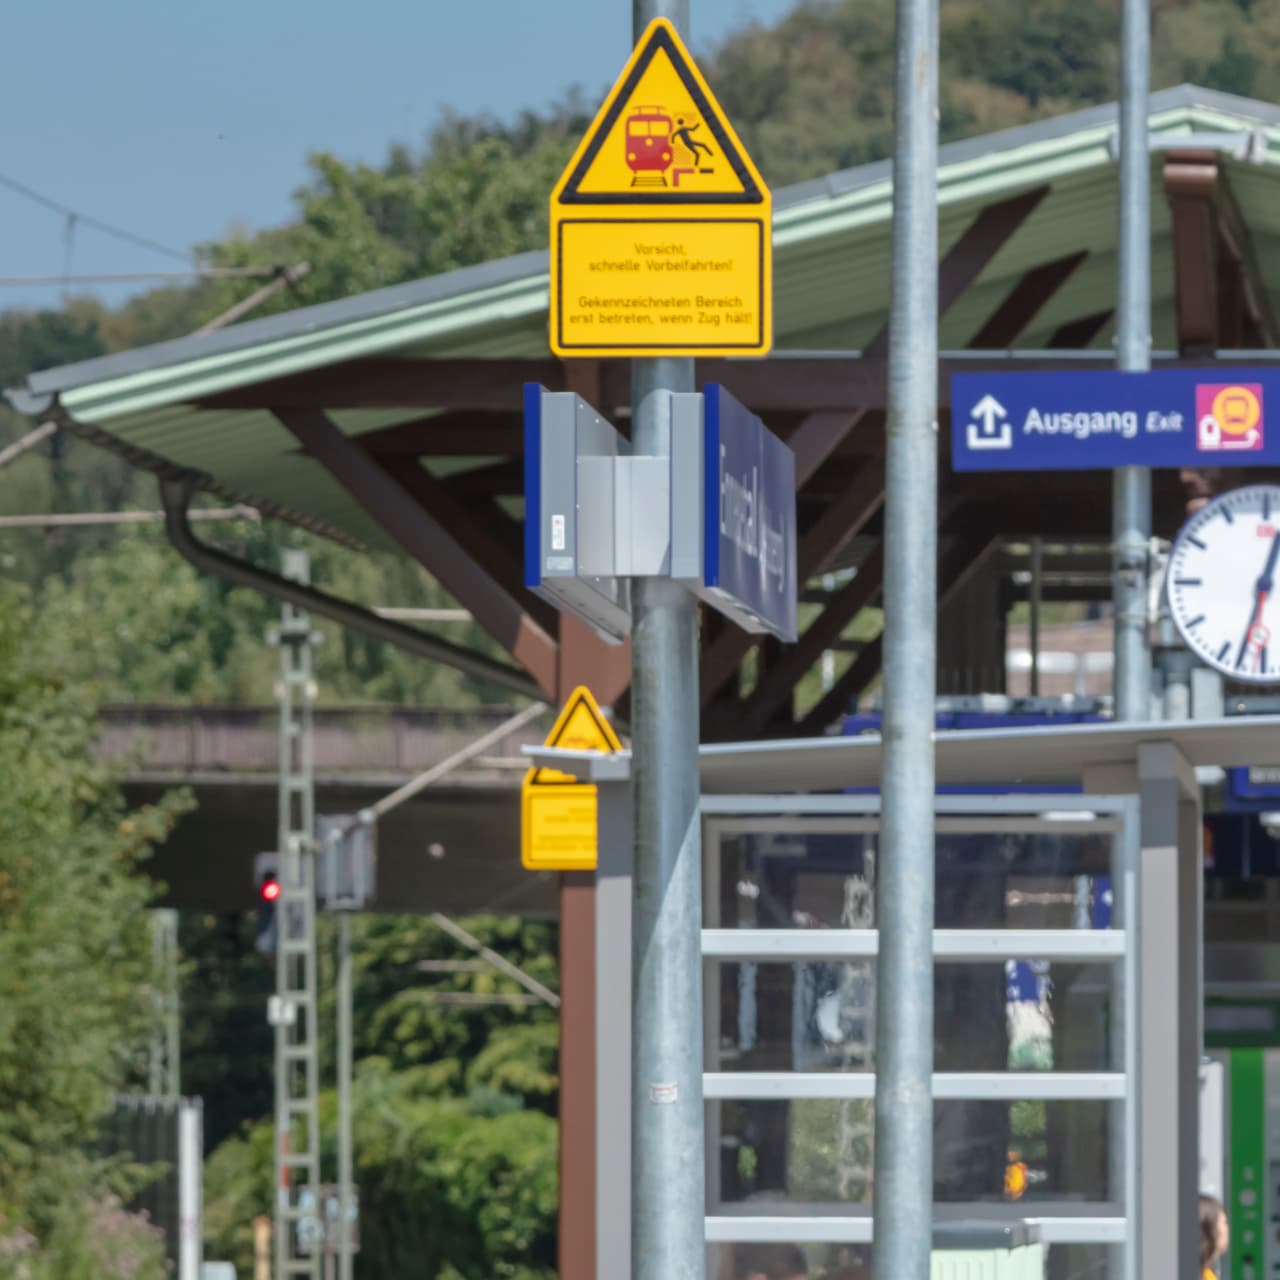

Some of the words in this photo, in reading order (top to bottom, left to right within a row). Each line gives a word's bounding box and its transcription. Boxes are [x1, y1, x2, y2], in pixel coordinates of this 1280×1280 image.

[633, 243, 687, 256] Vorsicht,
[589, 259, 640, 272] schnelle
[646, 259, 733, 272] Vorbeifahrten!
[578, 296, 691, 309] Gekennzeichneten
[695, 296, 743, 309] Bereich
[569, 312, 594, 324] erst
[598, 312, 654, 325] betreten,
[659, 313, 693, 324] wenn
[697, 312, 721, 327] Zug
[1023, 407, 1138, 439] Ausgang
[1145, 410, 1184, 433] Exit
